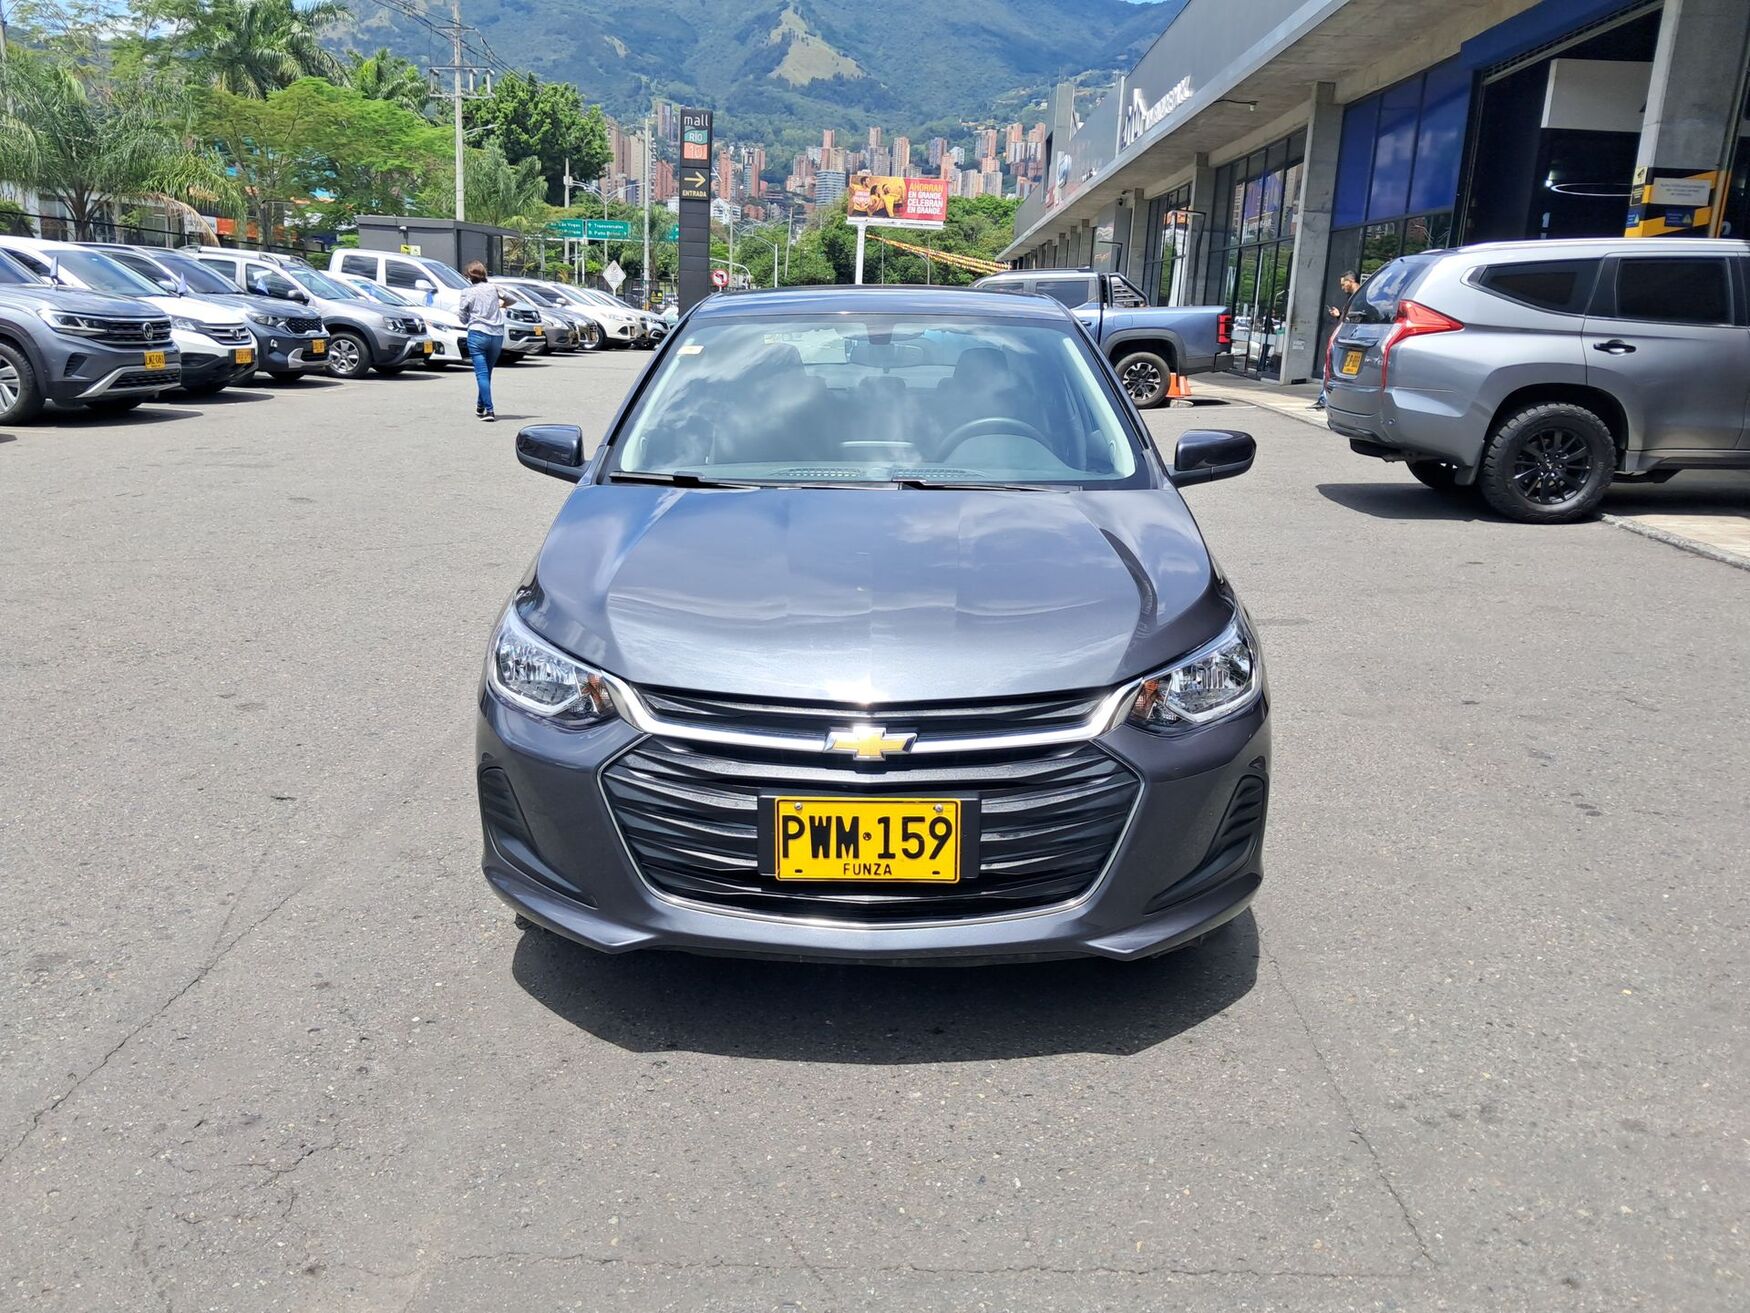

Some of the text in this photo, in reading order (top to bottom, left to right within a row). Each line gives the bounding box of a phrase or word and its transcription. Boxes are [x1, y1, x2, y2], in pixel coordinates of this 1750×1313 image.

[684, 114, 709, 127] mall
[908, 191, 917, 199] EN
[907, 198, 944, 208] CELEBRAN
[907, 206, 916, 214] EN
[781, 815, 953, 860] PWM 159
[843, 863, 893, 876] FUNZA
